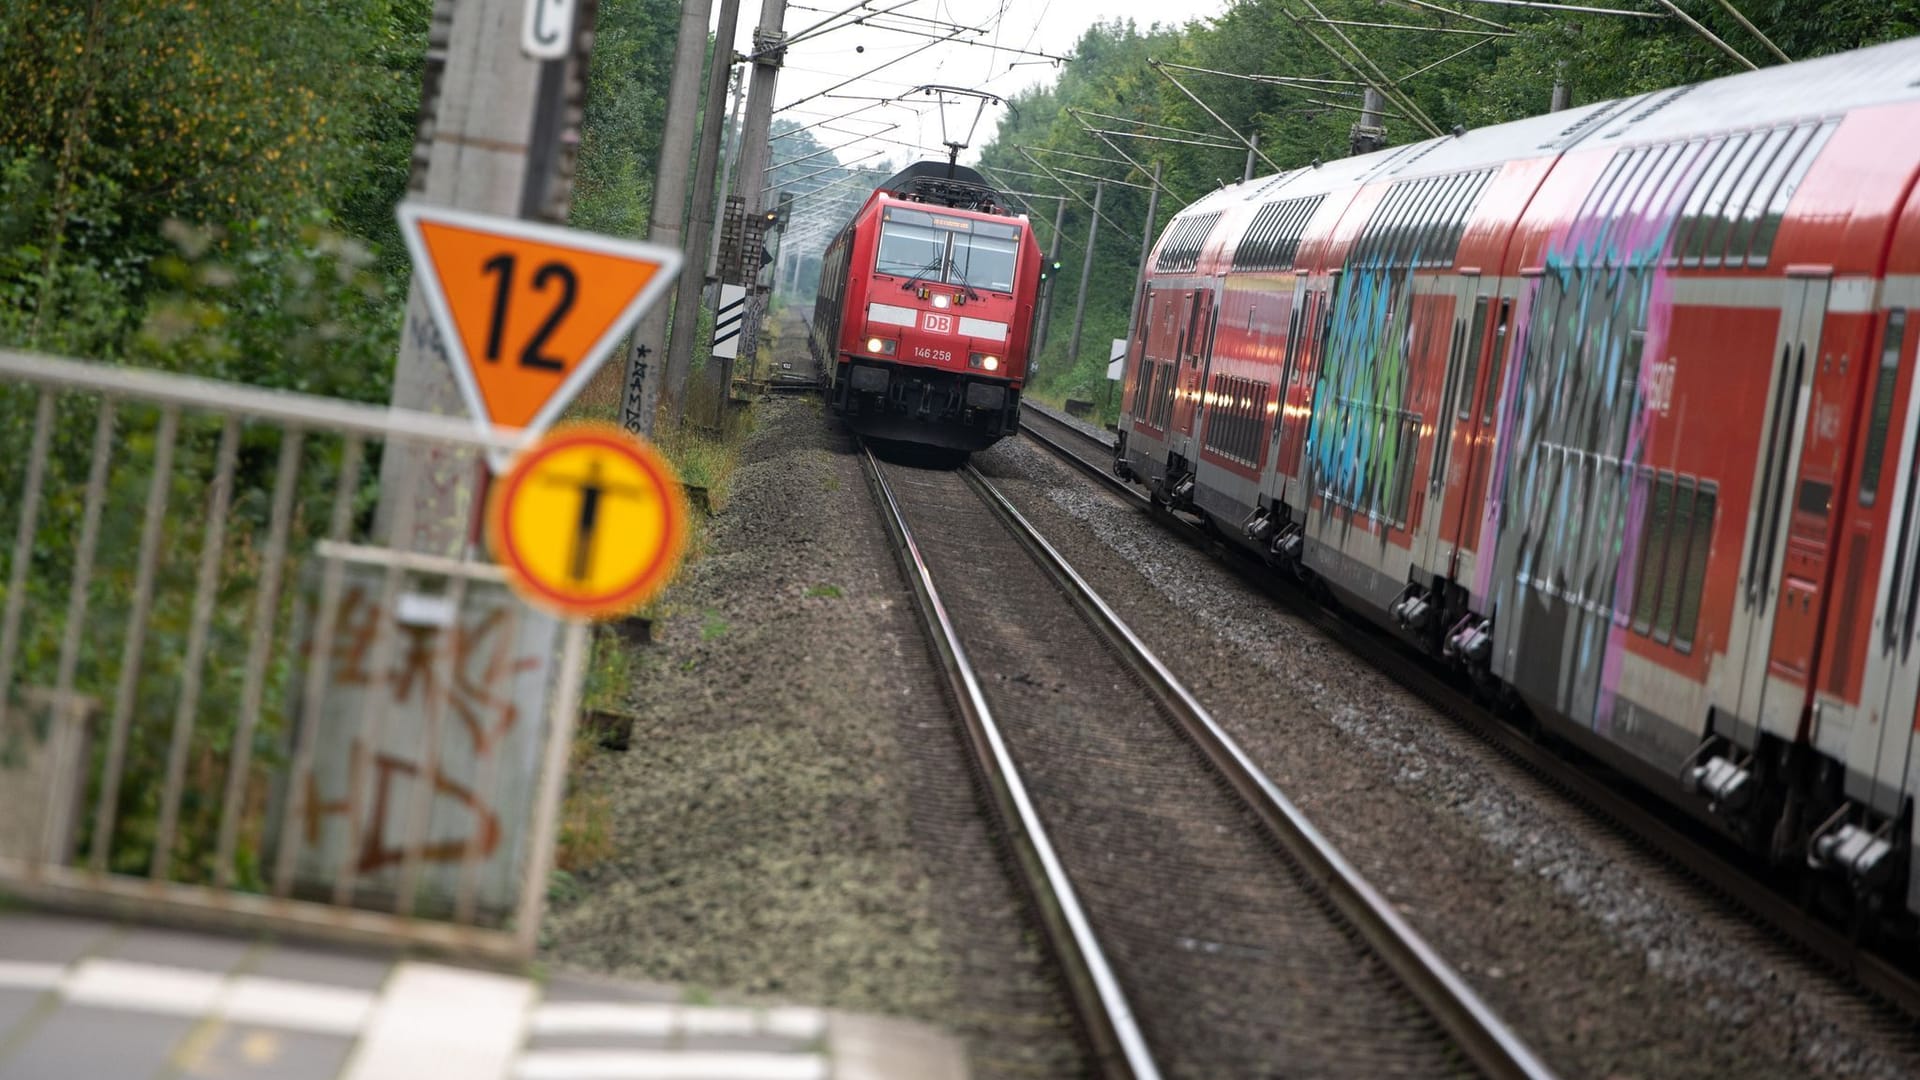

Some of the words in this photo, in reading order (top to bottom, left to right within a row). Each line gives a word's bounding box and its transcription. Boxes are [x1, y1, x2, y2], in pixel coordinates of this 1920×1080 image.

[483, 252, 578, 371] 12
[926, 315, 949, 331] DB
[915, 347, 931, 358] 146
[932, 350, 951, 361] 258
